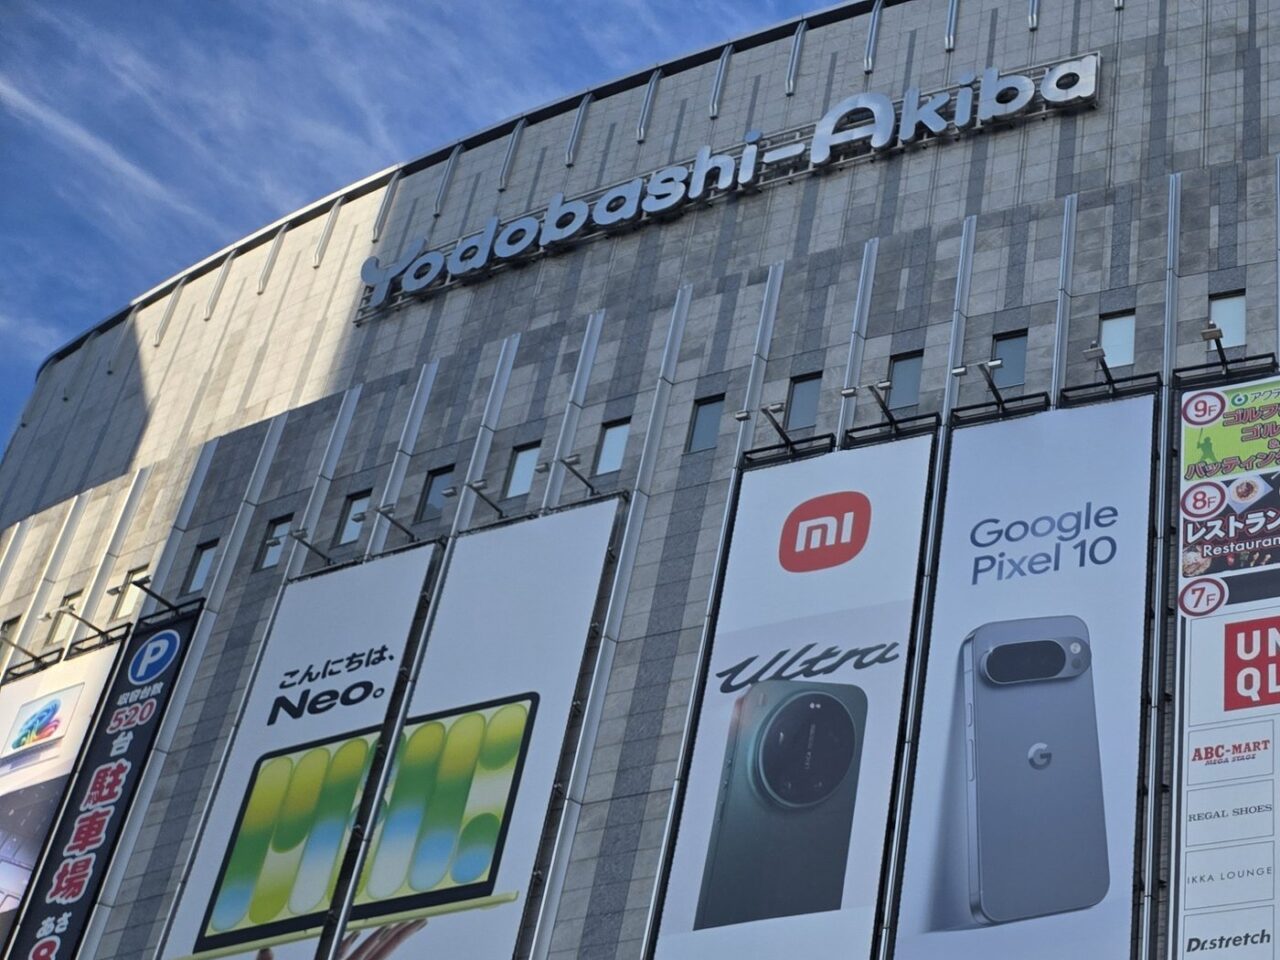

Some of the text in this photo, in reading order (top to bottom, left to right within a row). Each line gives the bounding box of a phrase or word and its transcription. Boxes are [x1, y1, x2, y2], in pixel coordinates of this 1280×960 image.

[361, 53, 1101, 308] Yodobashi-Akiba
[970, 502, 1119, 548] Google
[971, 535, 1117, 585] Pixel 10
[1191, 739, 1270, 761] ABC-MART
[1188, 804, 1273, 822] REGAL SHOES
[1187, 866, 1272, 884] IKKA LOUNGE
[1186, 929, 1271, 952] Dr.stretch
